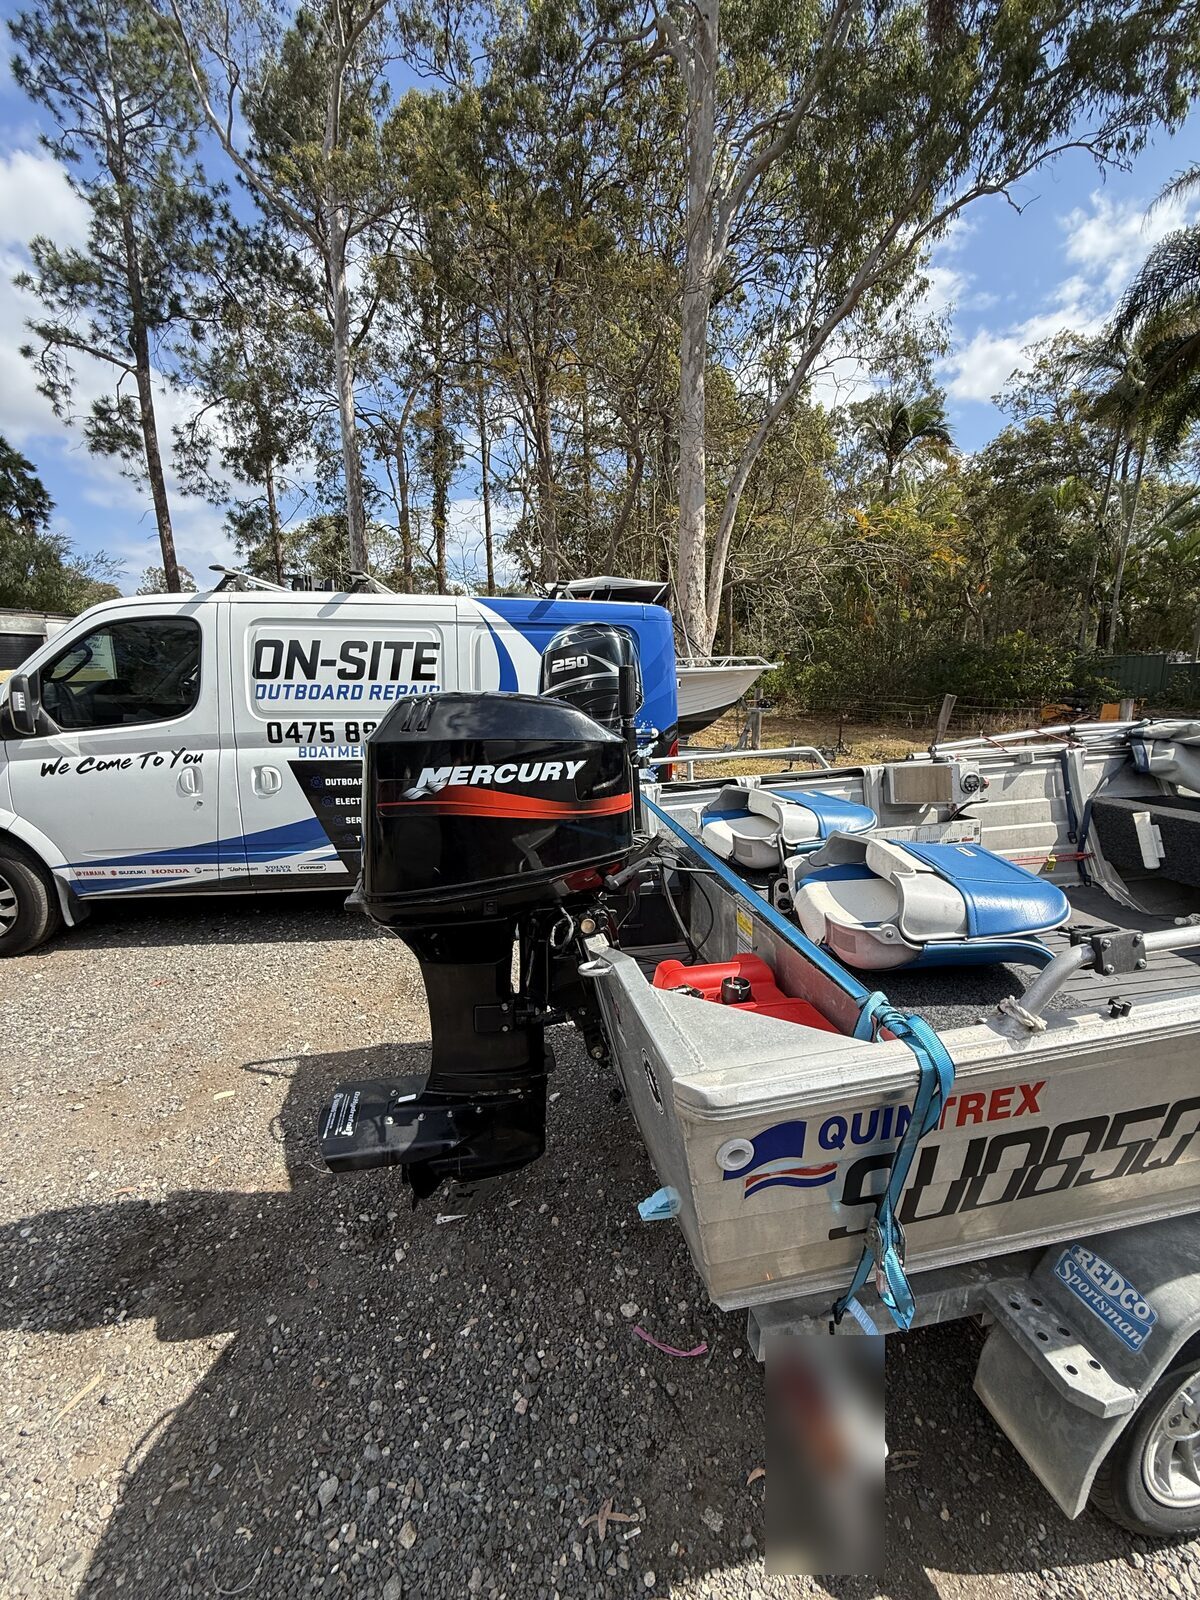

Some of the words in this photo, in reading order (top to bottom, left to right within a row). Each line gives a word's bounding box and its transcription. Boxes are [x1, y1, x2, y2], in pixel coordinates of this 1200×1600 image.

[252, 639, 440, 681] ON-SITE
[551, 655, 589, 674] 250
[255, 684, 364, 700] OUTBOARD
[266, 722, 335, 743] 0475
[40, 755, 71, 777] We
[76, 757, 133, 775] Come
[137, 751, 165, 770] To
[169, 747, 204, 768] You
[416, 759, 588, 789] MERCURY
[1075, 1247, 1151, 1319] REDCO
[1060, 1260, 1143, 1345] Sportsman
